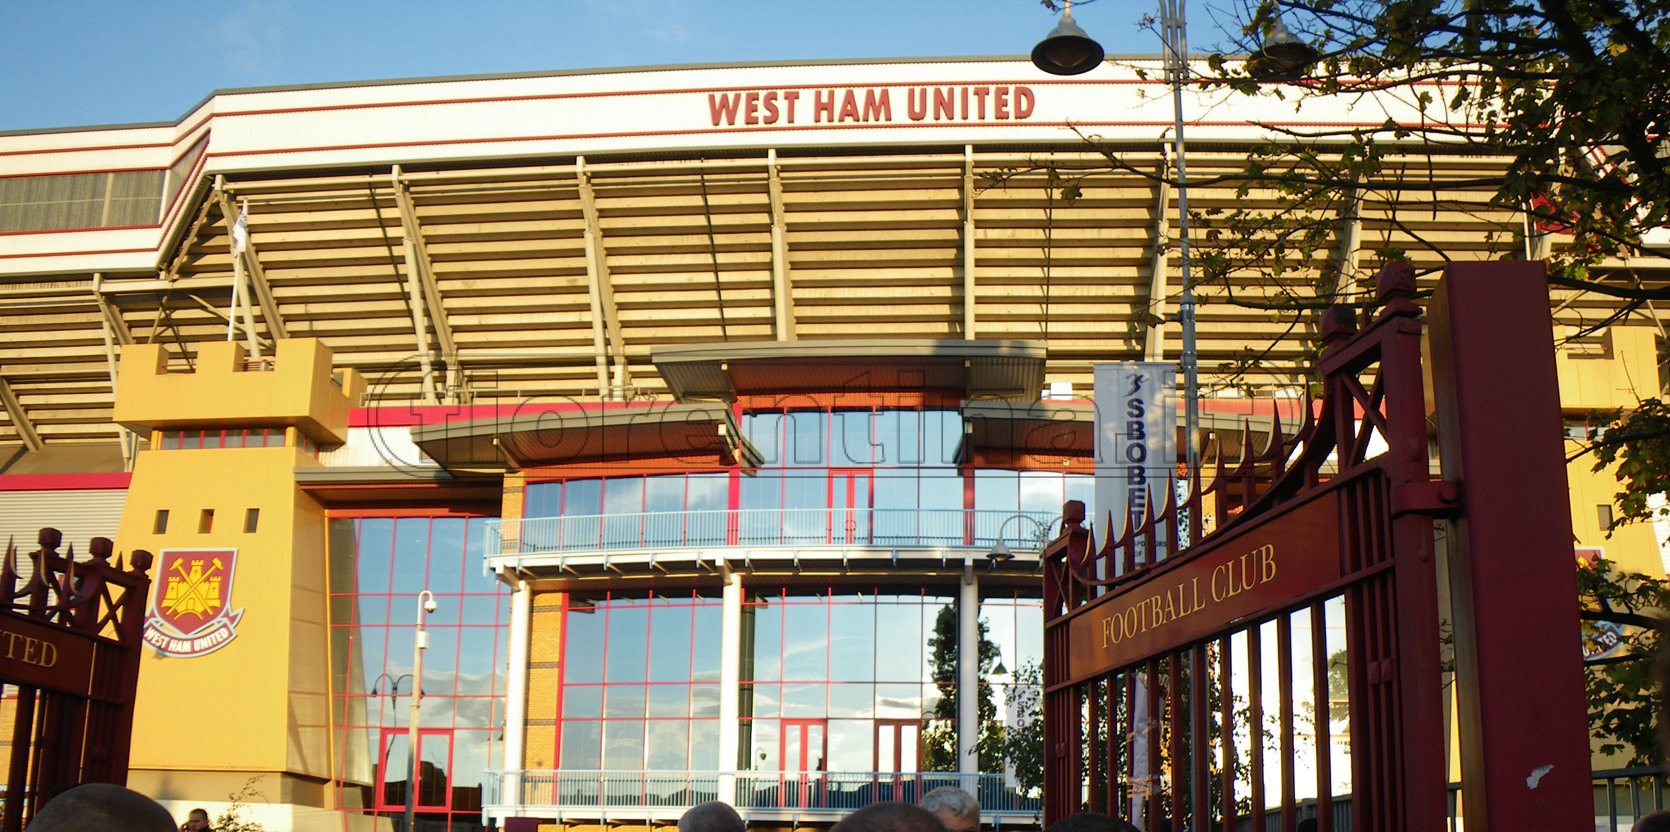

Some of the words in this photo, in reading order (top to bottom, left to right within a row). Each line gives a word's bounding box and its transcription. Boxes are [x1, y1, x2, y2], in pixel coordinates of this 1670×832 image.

[708, 90, 800, 127] WEST
[814, 89, 892, 123] HAM
[907, 86, 1036, 121] UNITED
[1126, 398, 1147, 530] SBOBET
[1102, 576, 1205, 649] FOOTBALL
[1211, 544, 1277, 602] CLUB
[0, 629, 58, 668] TED
[144, 627, 170, 649] WEST
[168, 639, 192, 652] HAM
[194, 627, 229, 651] UNITED
